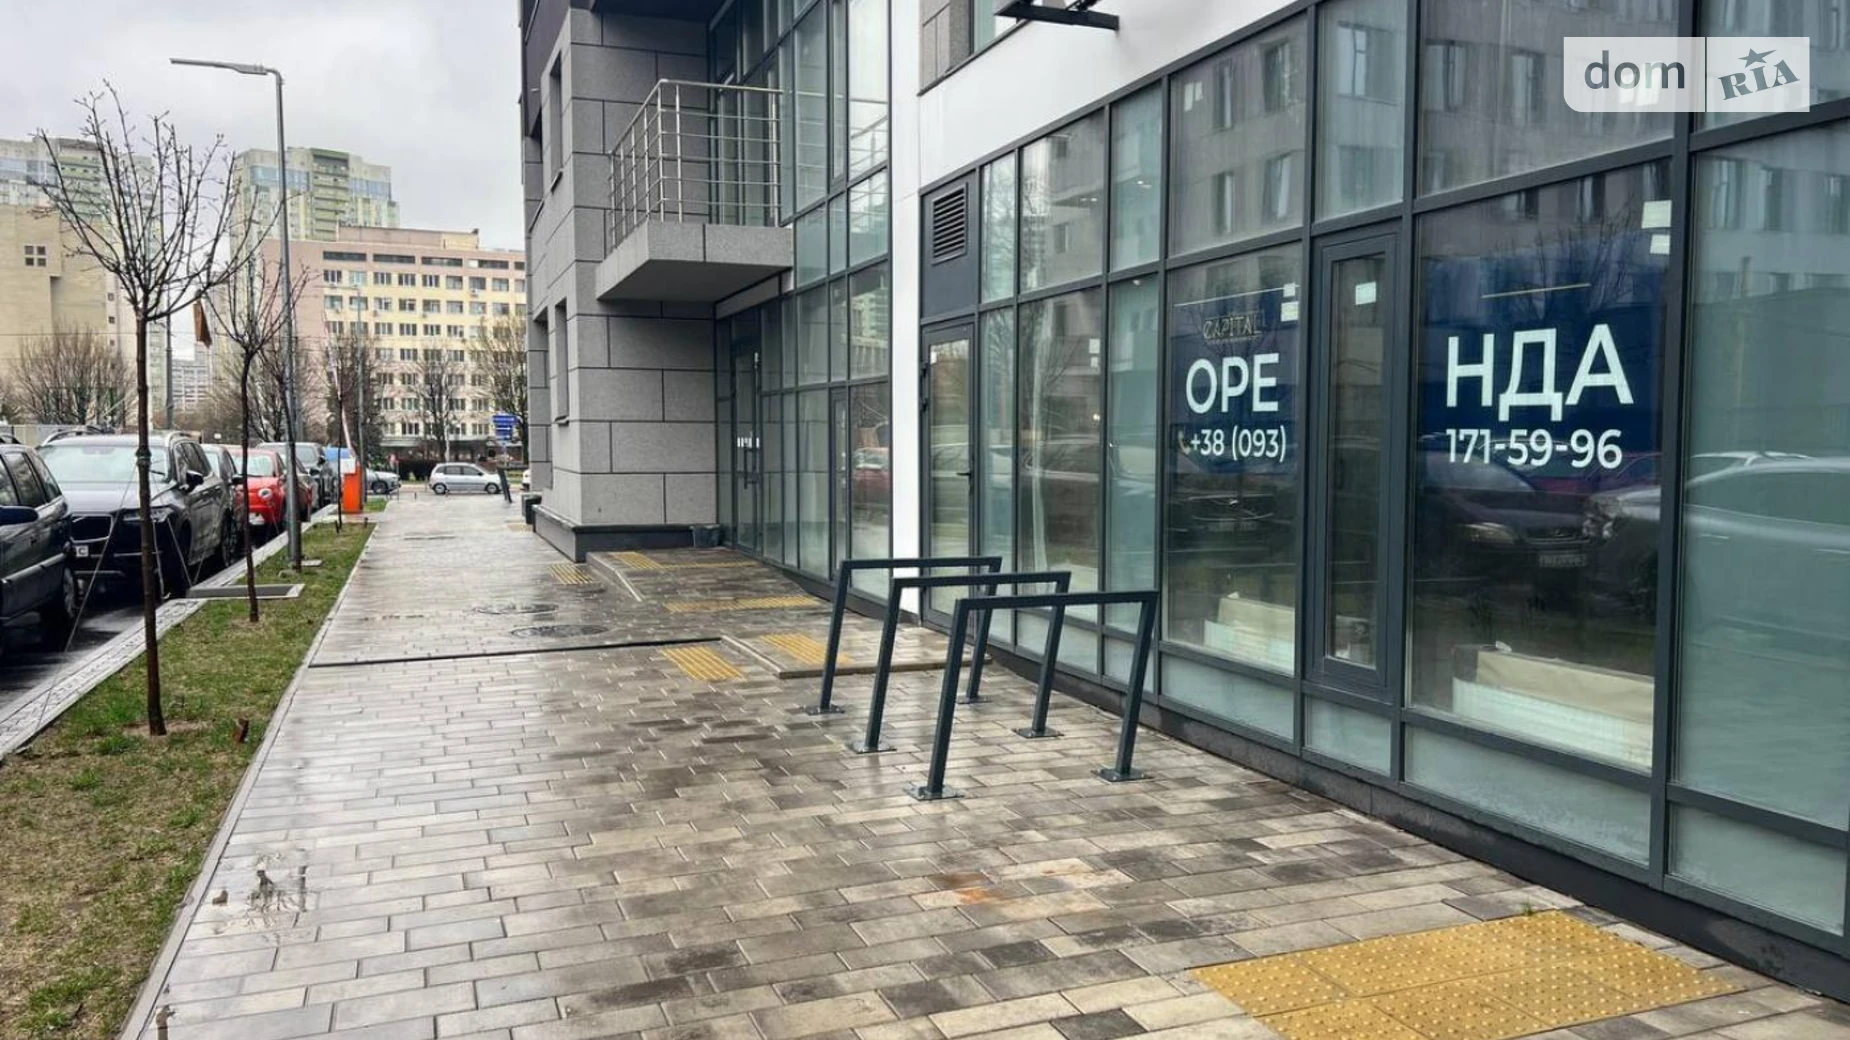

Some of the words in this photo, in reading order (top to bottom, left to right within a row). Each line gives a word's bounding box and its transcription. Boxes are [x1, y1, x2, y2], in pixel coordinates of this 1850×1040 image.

[1185, 352, 1280, 415] ОРЕ
[1446, 323, 1635, 422] НДА
[1190, 429, 1225, 457] +38
[1231, 425, 1287, 463] (093)
[1446, 428, 1623, 469] 171-59-96
